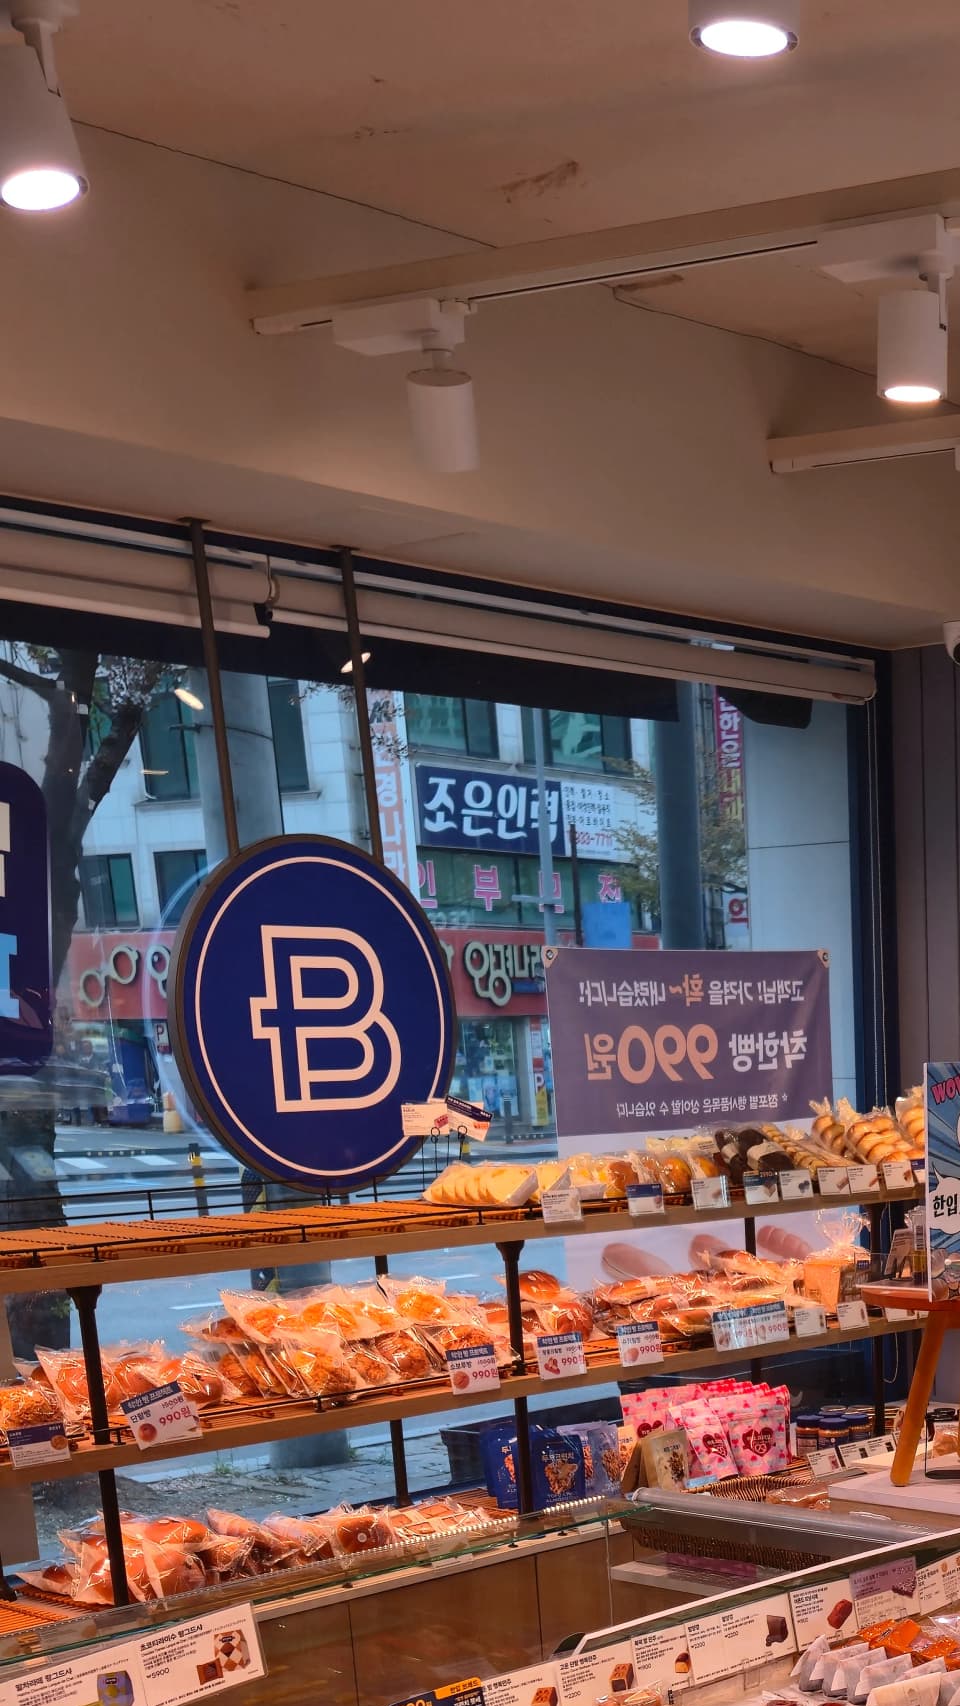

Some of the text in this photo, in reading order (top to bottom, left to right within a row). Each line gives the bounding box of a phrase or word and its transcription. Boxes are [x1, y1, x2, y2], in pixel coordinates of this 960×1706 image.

[424, 776, 559, 842] 조은인력
[472, 1367, 500, 1380] 990원
[129, 1409, 151, 1425] 단팥빵
[159, 1407, 191, 1427] 990원
